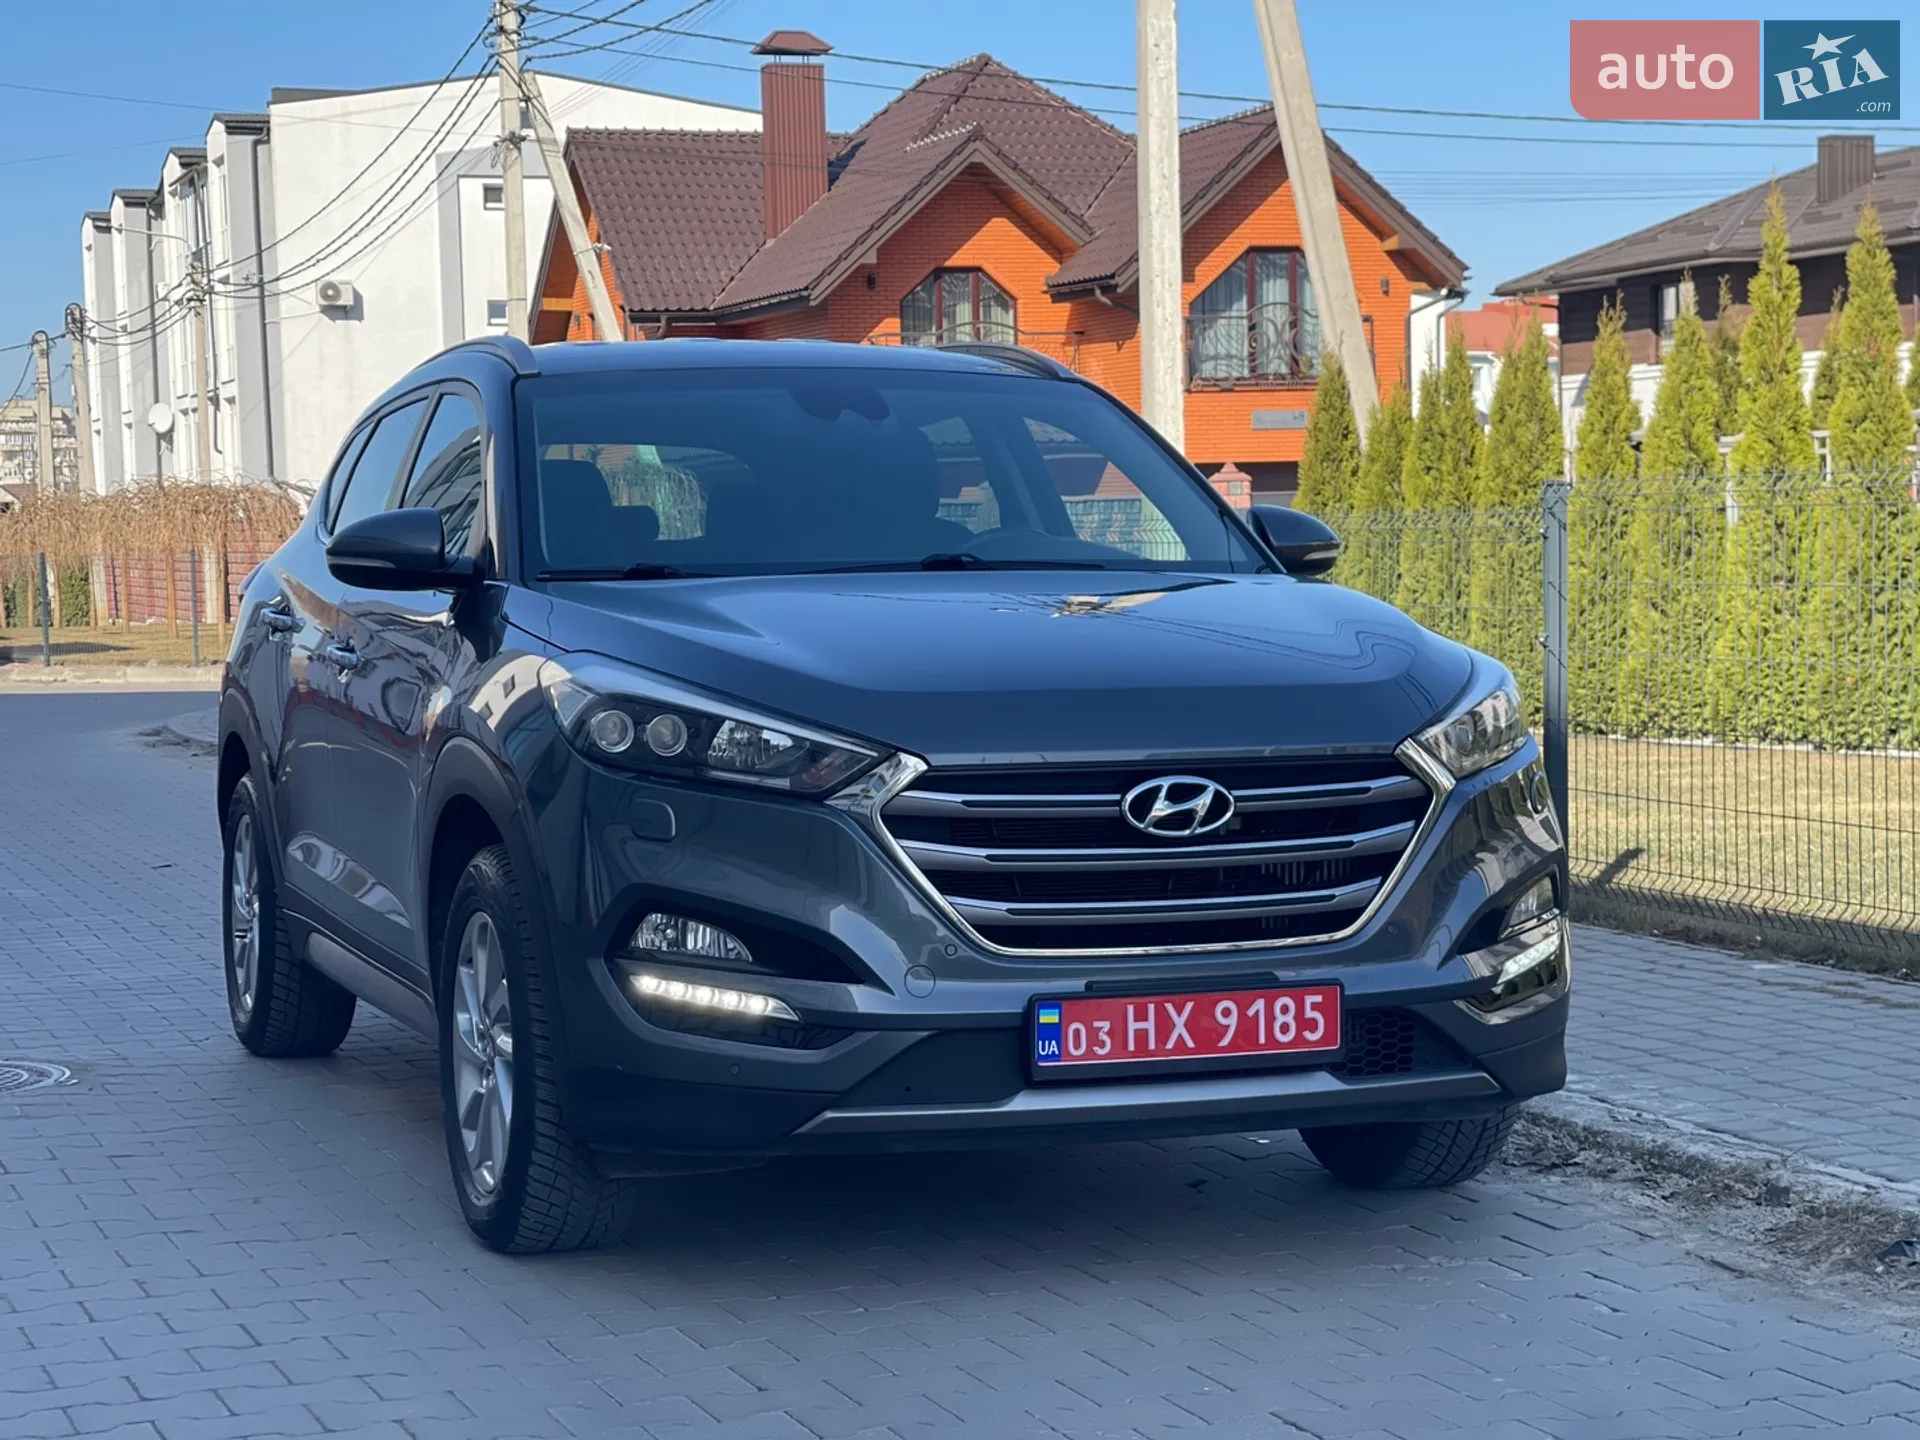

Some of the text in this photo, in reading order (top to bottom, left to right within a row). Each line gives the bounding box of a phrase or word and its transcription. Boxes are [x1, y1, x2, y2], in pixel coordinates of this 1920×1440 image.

[1067, 994, 1325, 1056] 03 HX 9185
[1038, 1040, 1059, 1055] UA
